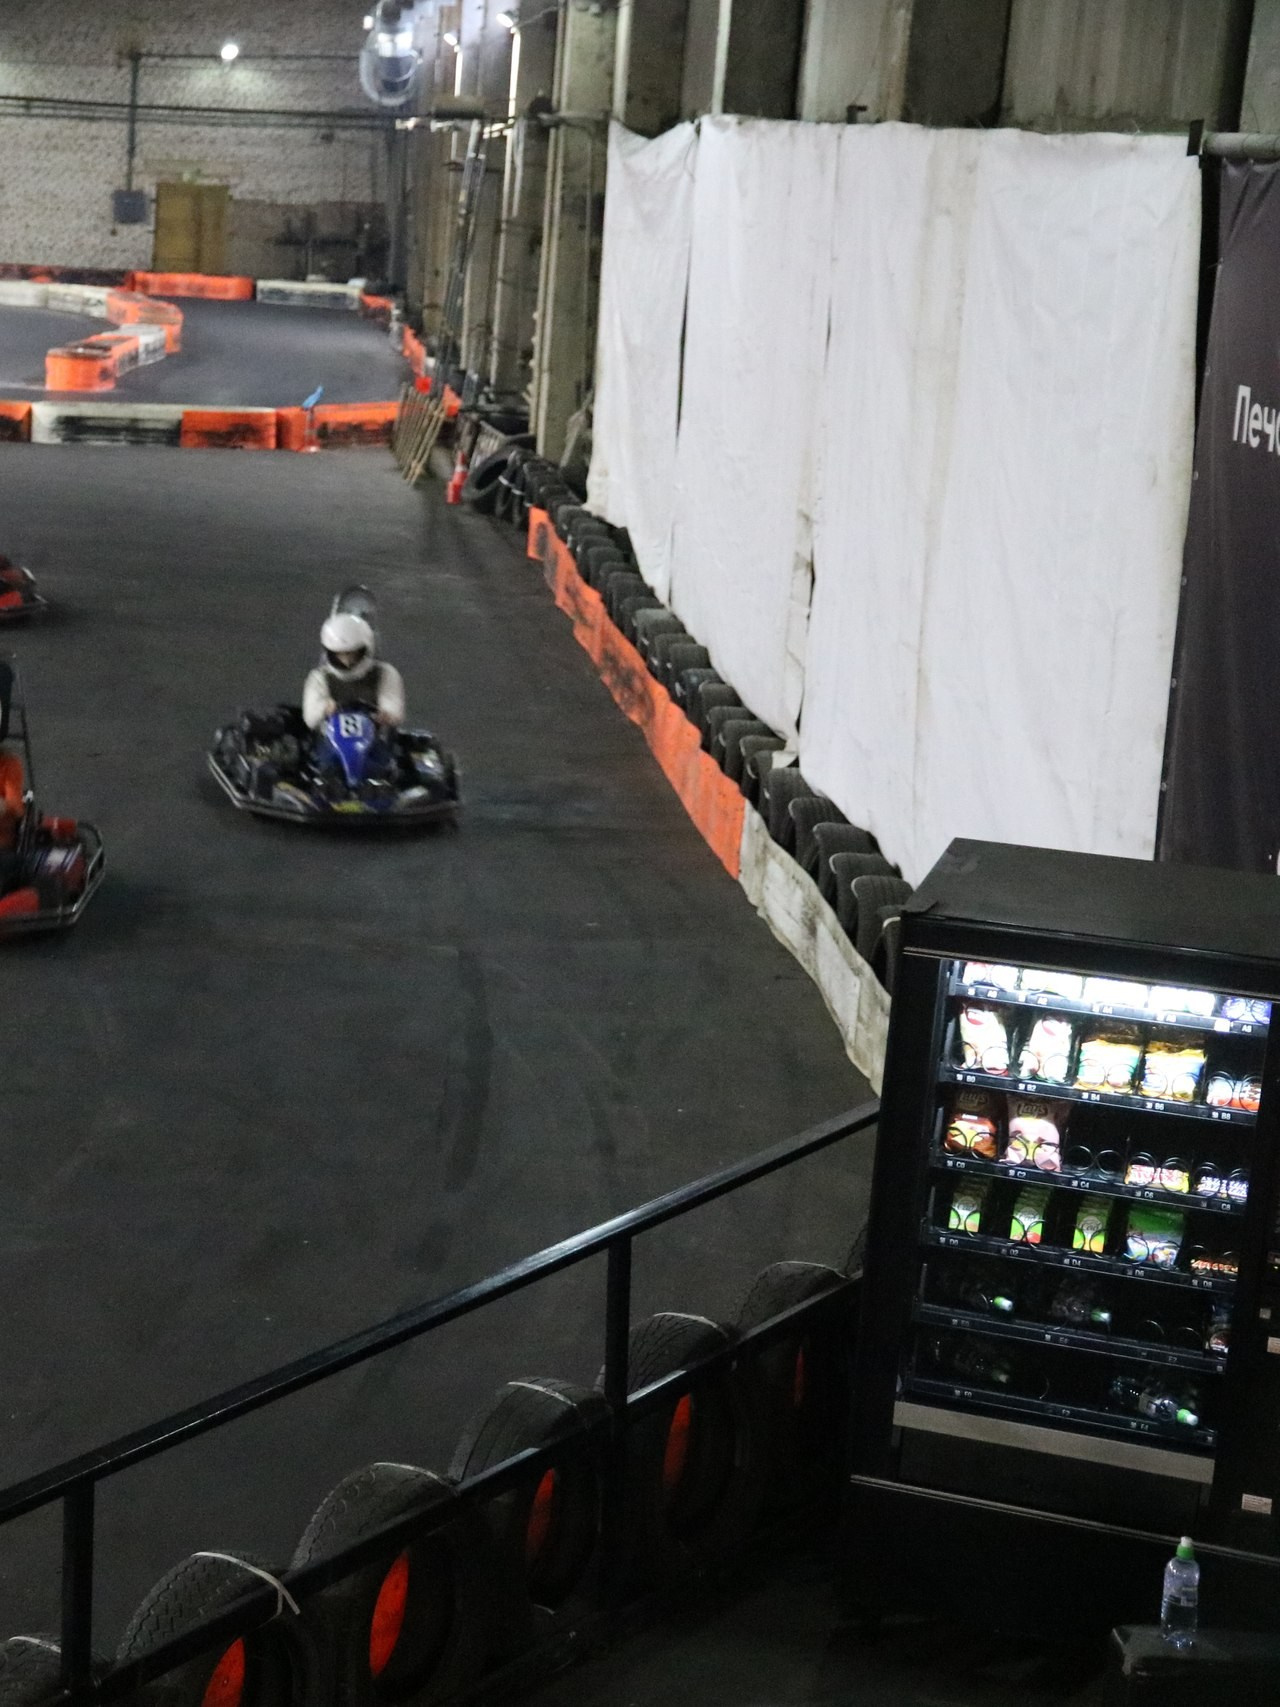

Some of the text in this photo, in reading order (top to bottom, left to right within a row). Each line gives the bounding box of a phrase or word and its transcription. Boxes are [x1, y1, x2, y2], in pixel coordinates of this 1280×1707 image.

[1027, 1083, 1037, 1092] B2
[1090, 1093, 1100, 1101] B4
[1017, 1169, 1026, 1178] C2
[1080, 1180, 1090, 1189] C4
[1072, 1258, 1081, 1267] D4
